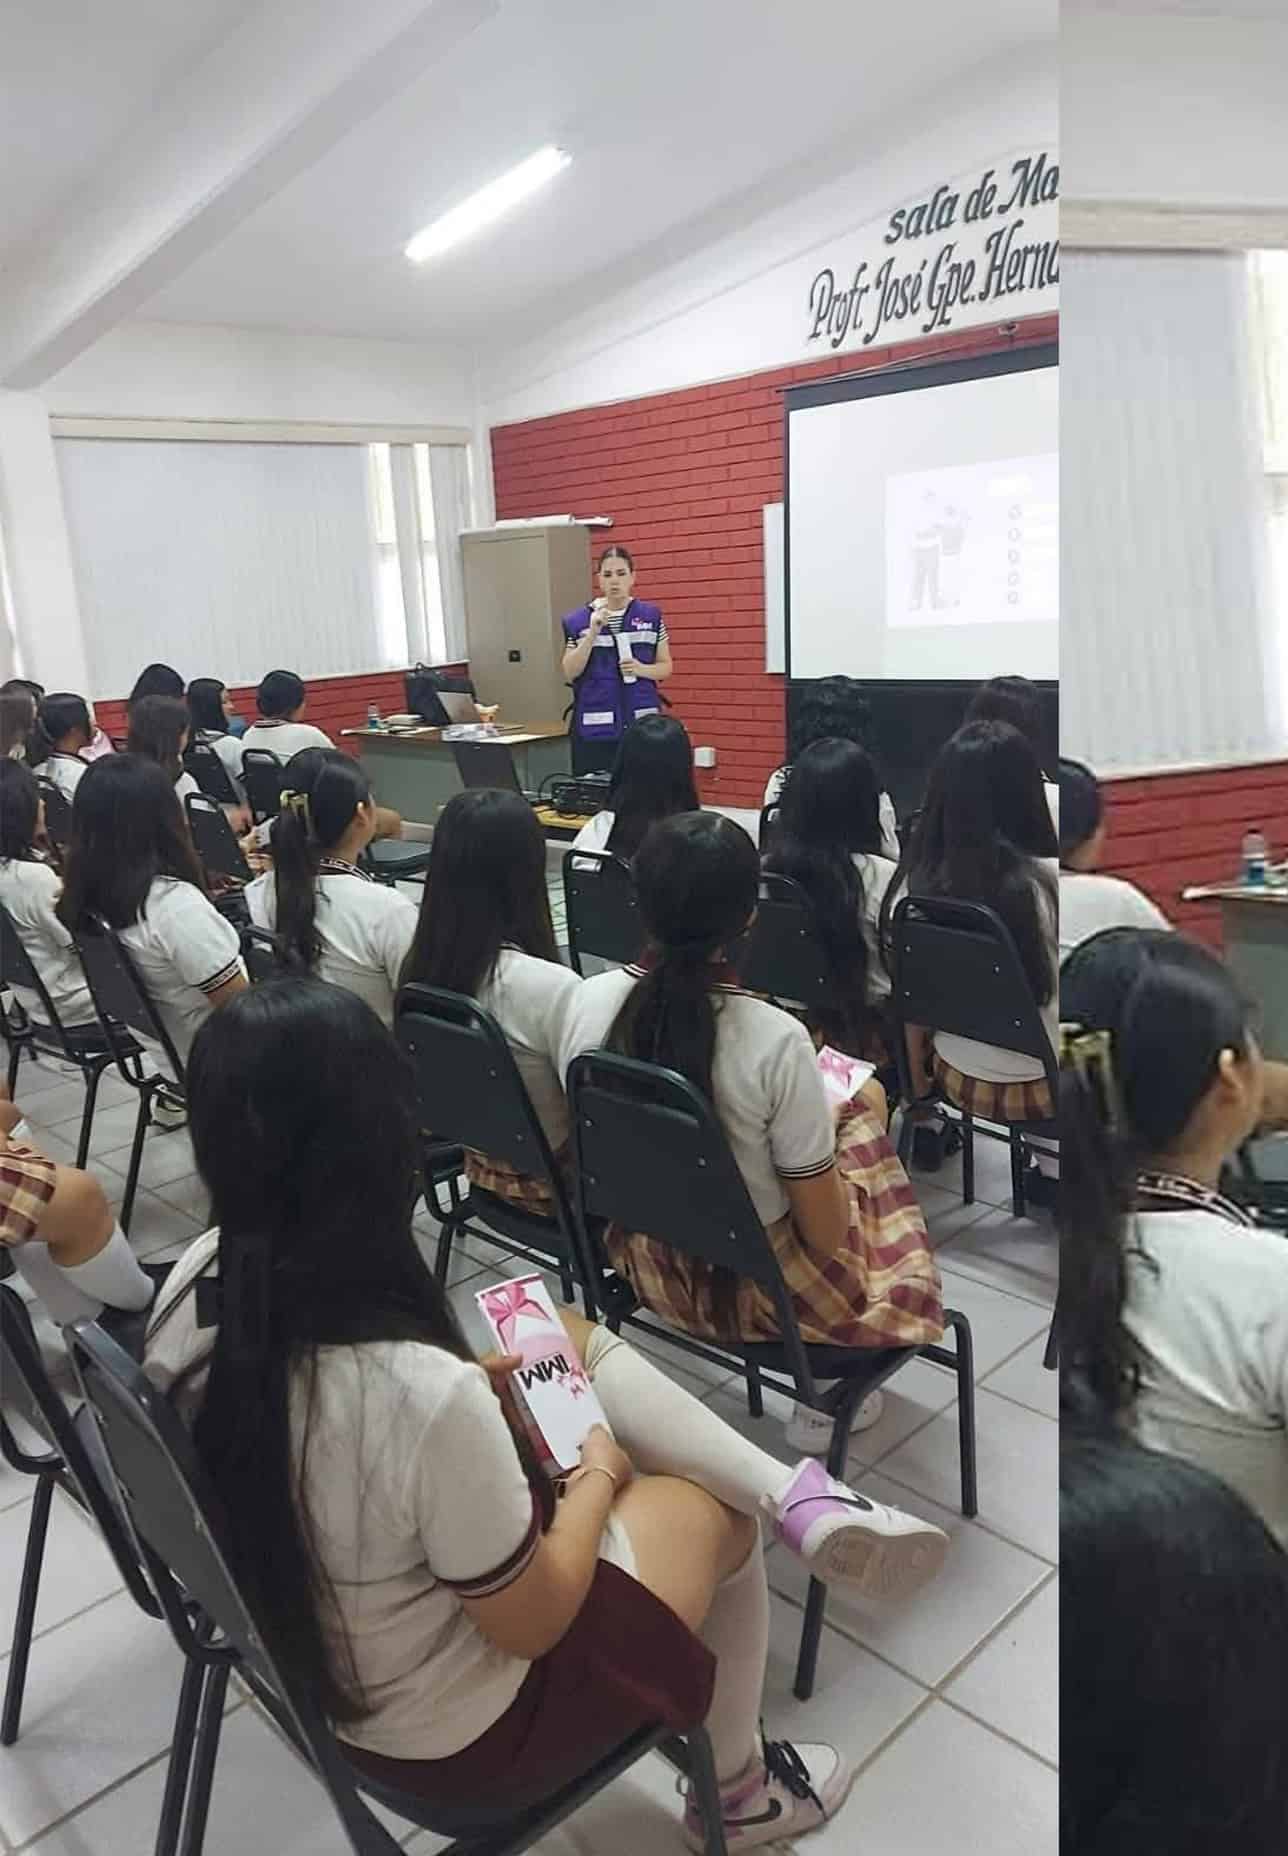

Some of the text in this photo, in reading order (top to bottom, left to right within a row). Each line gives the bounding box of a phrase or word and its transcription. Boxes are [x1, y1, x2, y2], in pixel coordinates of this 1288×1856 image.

[885, 184, 960, 244] sala
[963, 170, 997, 224] de
[863, 257, 928, 344] José
[922, 241, 976, 333] Gpe.
